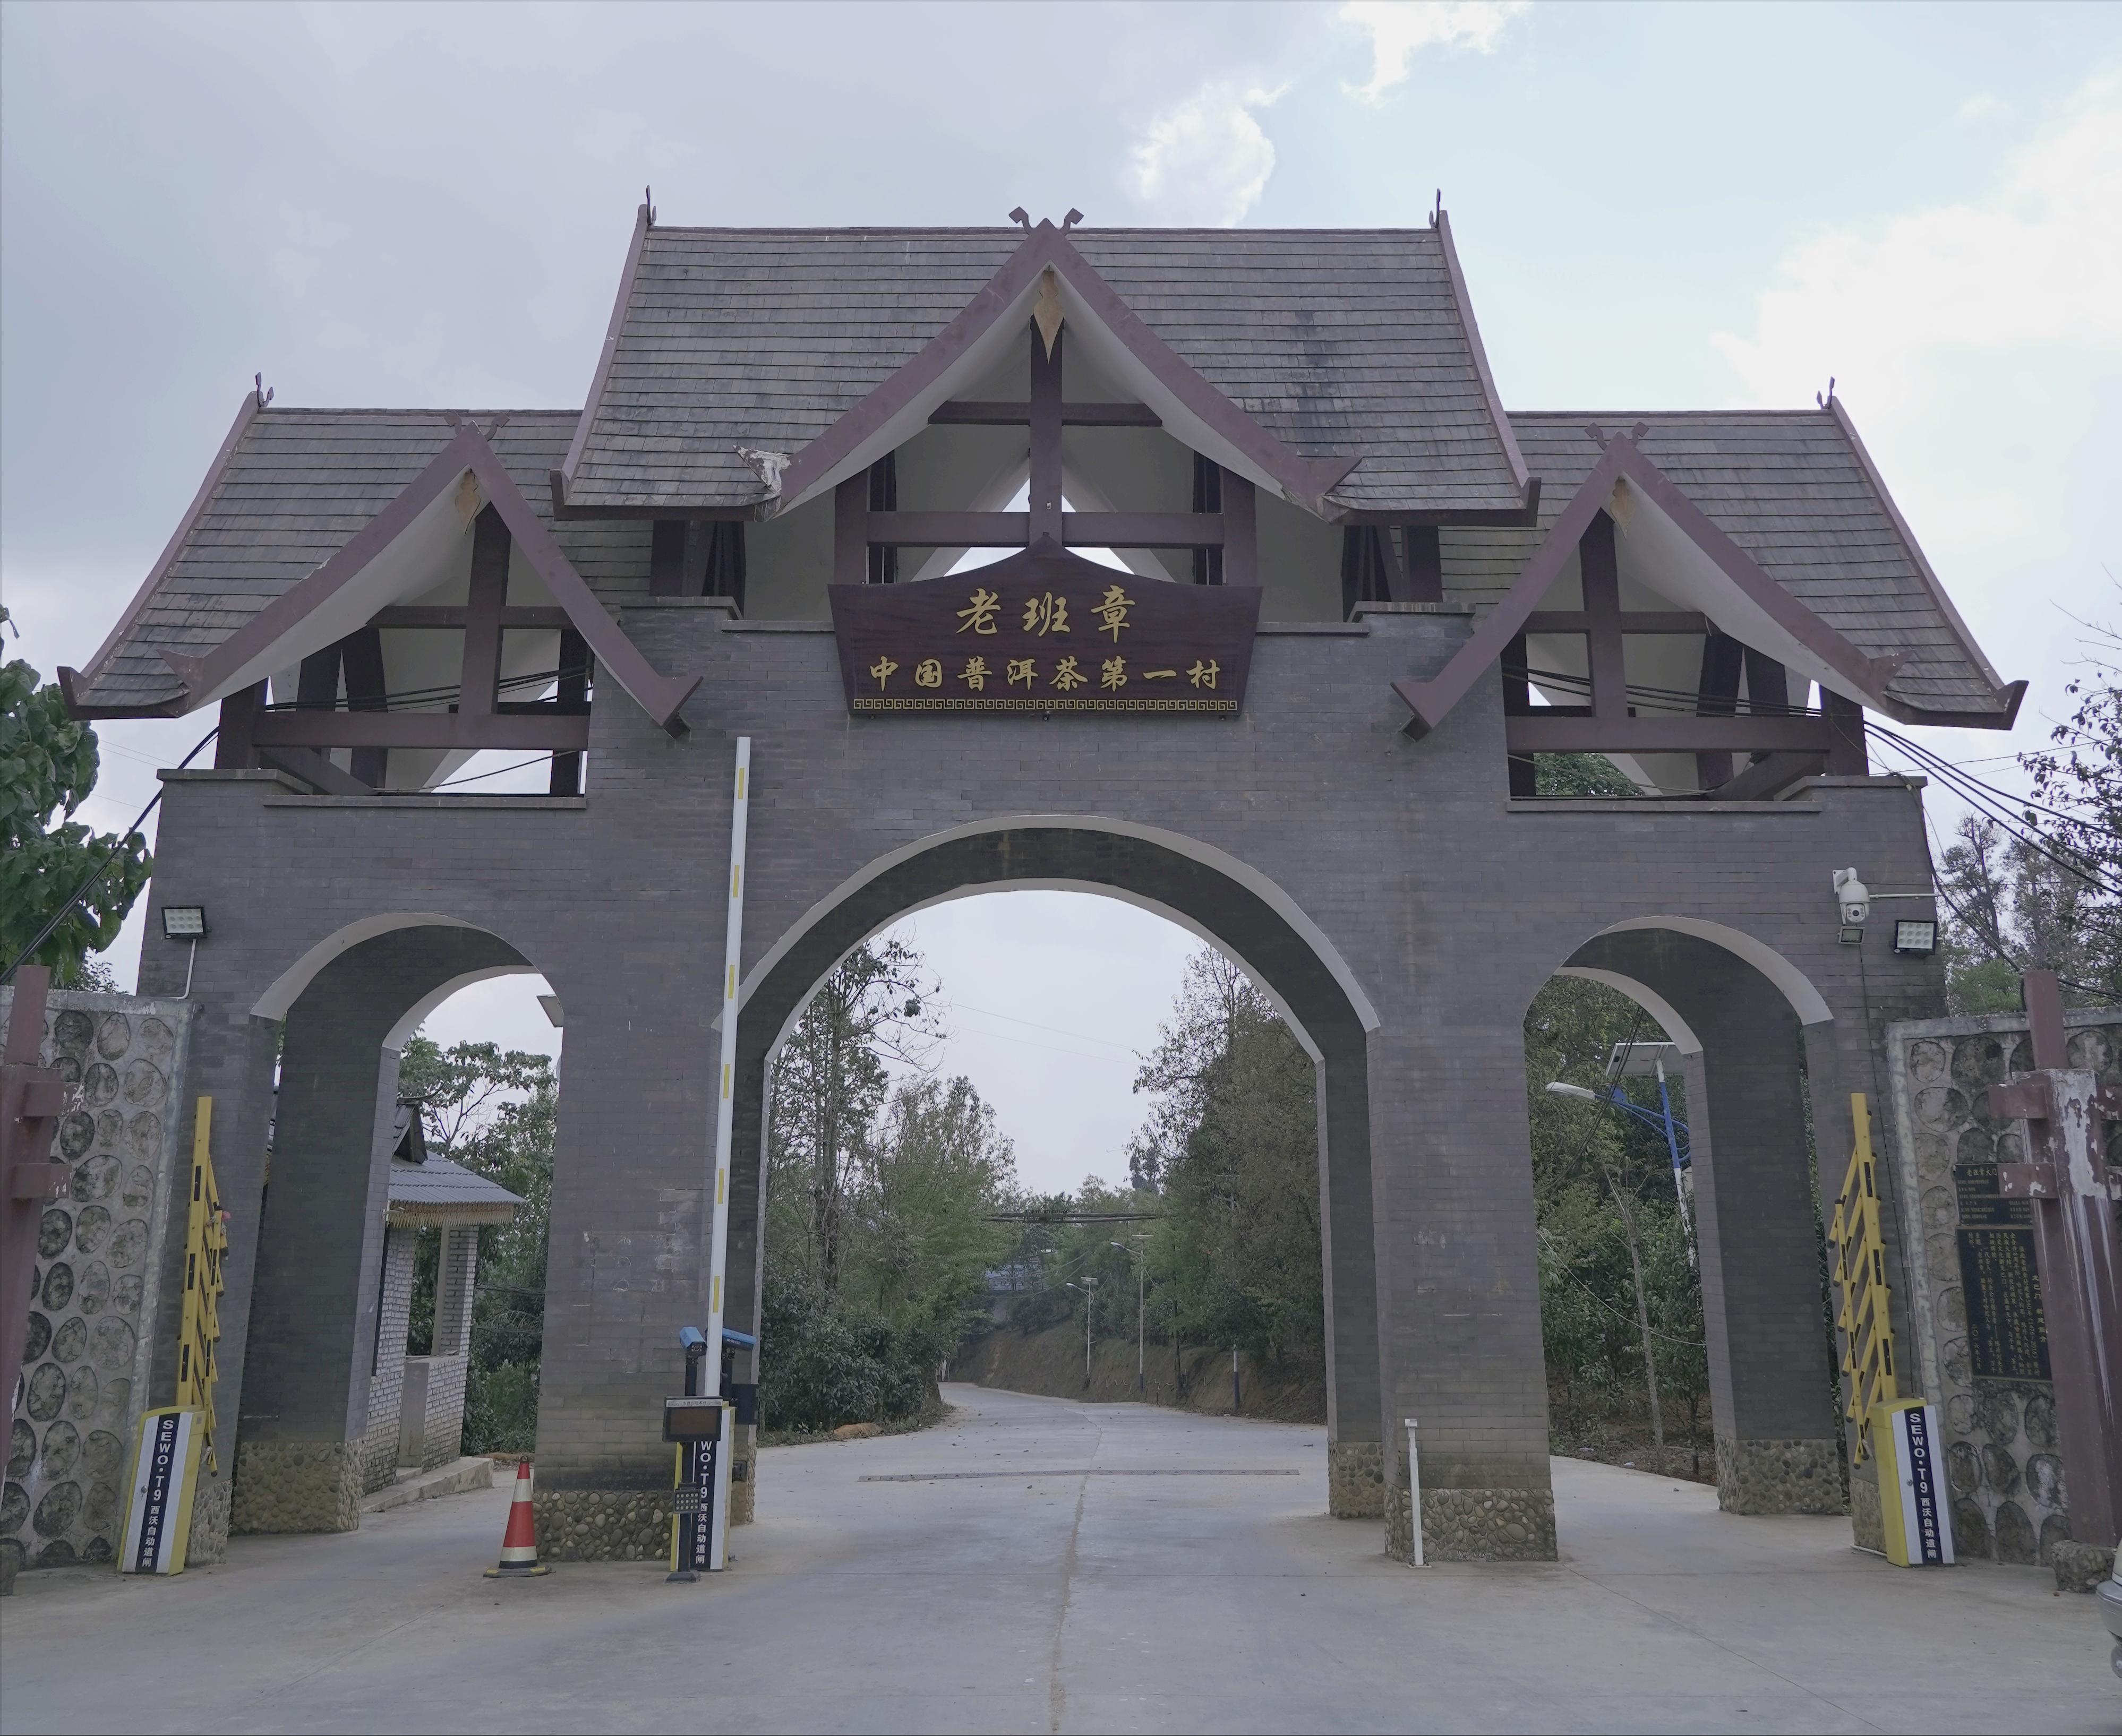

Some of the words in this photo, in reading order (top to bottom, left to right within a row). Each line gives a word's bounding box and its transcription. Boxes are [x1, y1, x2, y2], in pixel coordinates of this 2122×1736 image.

[956, 585, 1136, 643] 老班章
[869, 656, 1221, 692] 中国普洱茶第一村
[142, 1506, 160, 1567] 西沃自动道闸
[1920, 1497, 1937, 1559] 西沃自动道闸
